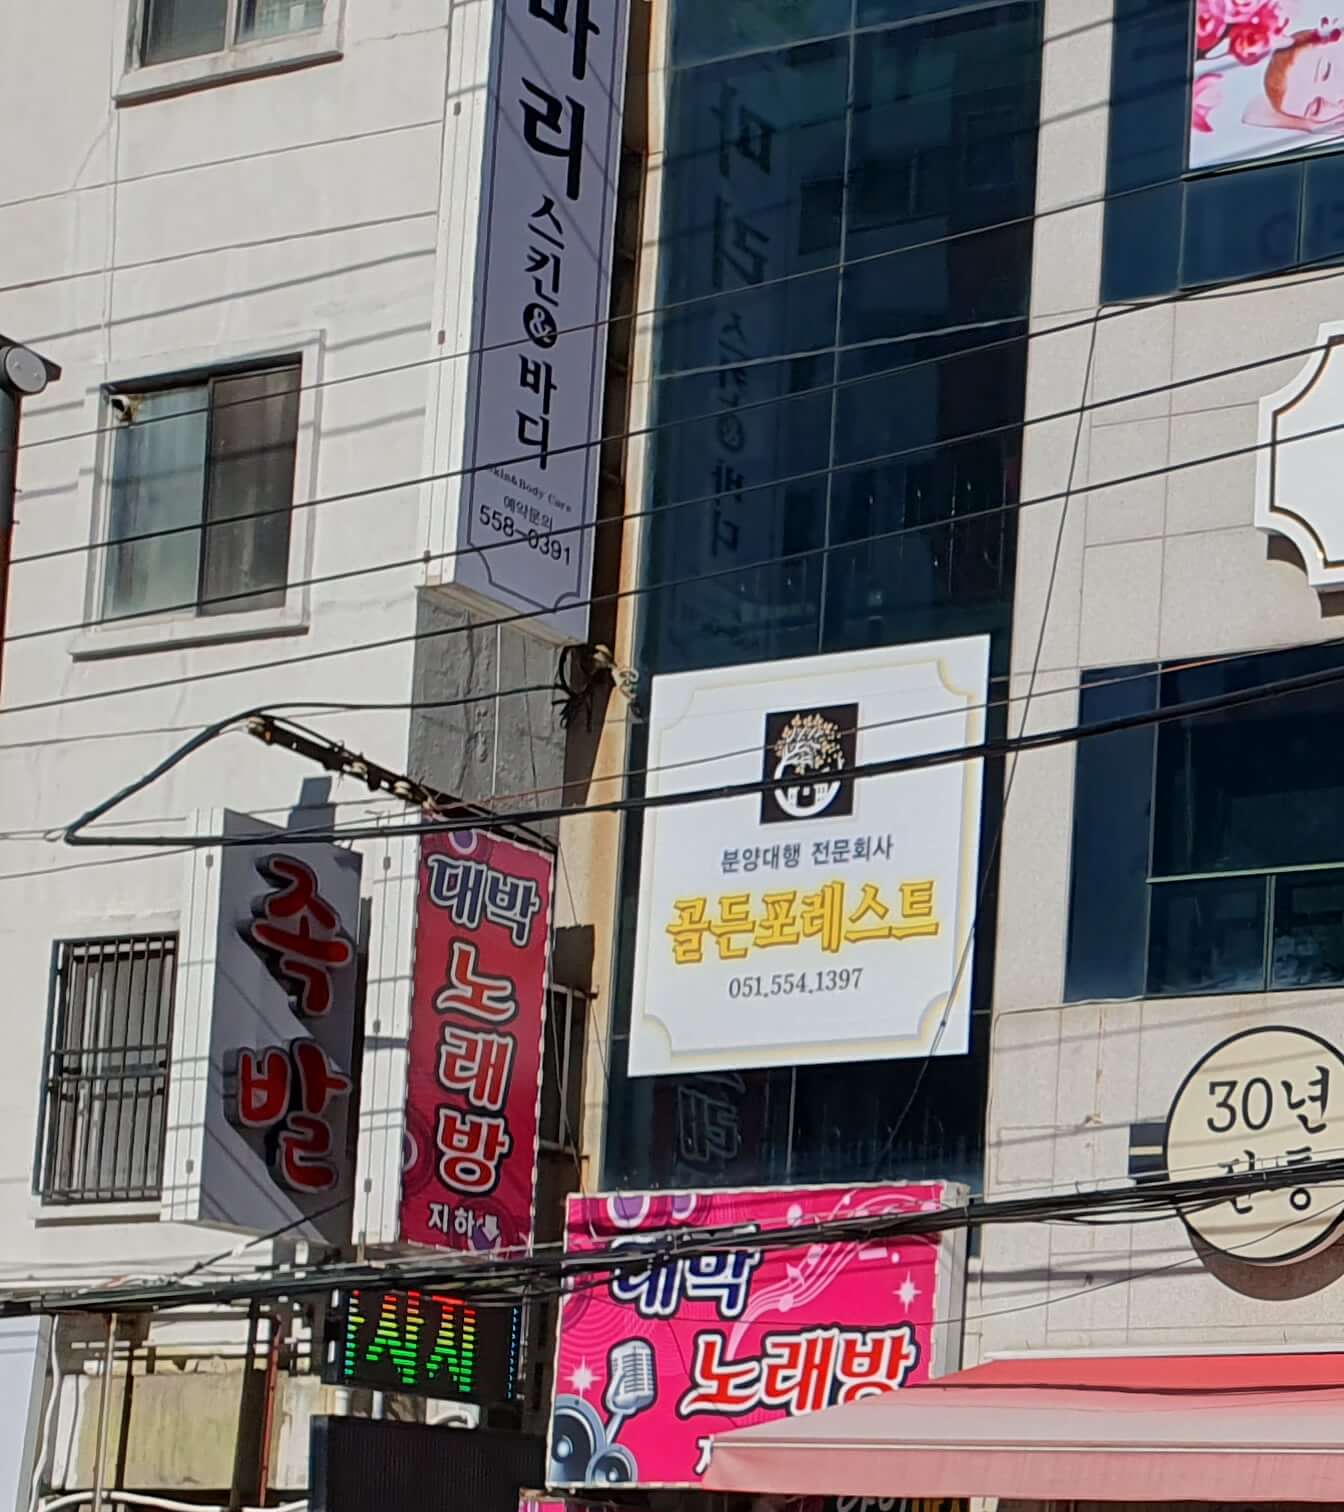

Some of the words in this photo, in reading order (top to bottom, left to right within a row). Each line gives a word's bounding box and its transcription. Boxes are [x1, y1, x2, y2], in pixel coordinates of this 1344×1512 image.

[479, 504, 571, 566] 558-0391
[720, 843, 801, 874] 분양대행
[811, 834, 893, 865] 전문회사
[427, 852, 541, 946] 대박
[665, 880, 940, 965] 골든포레스트
[728, 968, 864, 999] 051.554.1397
[238, 856, 351, 1192] 족발
[437, 942, 518, 1196] 노래방
[1206, 1065, 1330, 1135] 30년
[427, 1202, 476, 1240] 지하
[677, 1321, 920, 1419] 노래방
